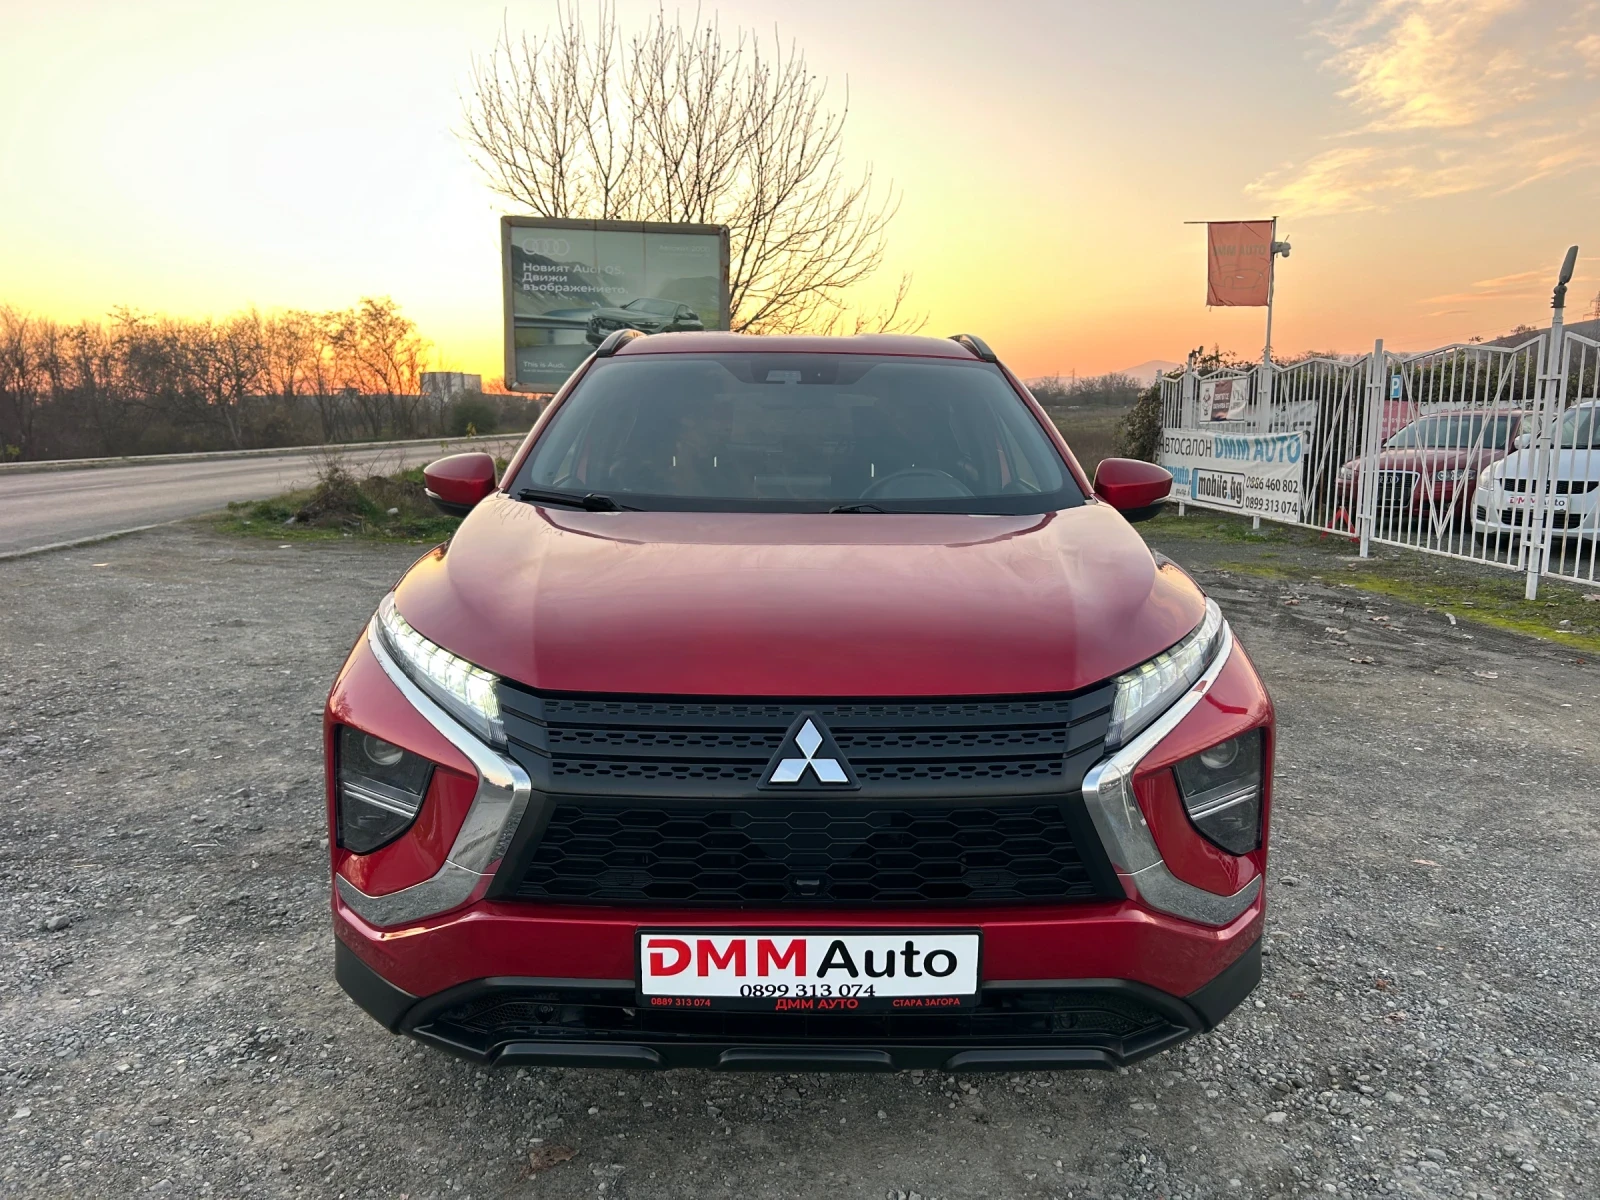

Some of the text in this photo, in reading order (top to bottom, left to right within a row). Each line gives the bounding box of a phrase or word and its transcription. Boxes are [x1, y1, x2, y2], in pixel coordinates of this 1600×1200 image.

[1239, 244, 1266, 256] AUTO
[523, 262, 570, 273] Новият
[522, 272, 568, 283] Движи
[523, 283, 629, 294] въображението.
[523, 360, 539, 368] This
[539, 361, 547, 369] is
[1214, 434, 1250, 460] DMM
[1253, 435, 1302, 464] AUTO
[1197, 473, 1243, 504] mobile.bg
[1265, 477, 1281, 491] 460
[1282, 480, 1298, 494] 802
[1245, 497, 1298, 515] 0899 313 074
[816, 939, 958, 979] Auto
[739, 983, 876, 998] 0899 313 074
[650, 998, 711, 1007] 0889 313 074
[775, 998, 859, 1010] ДММ АУТО
[893, 998, 960, 1007] СТАРА ЗАГОРА
